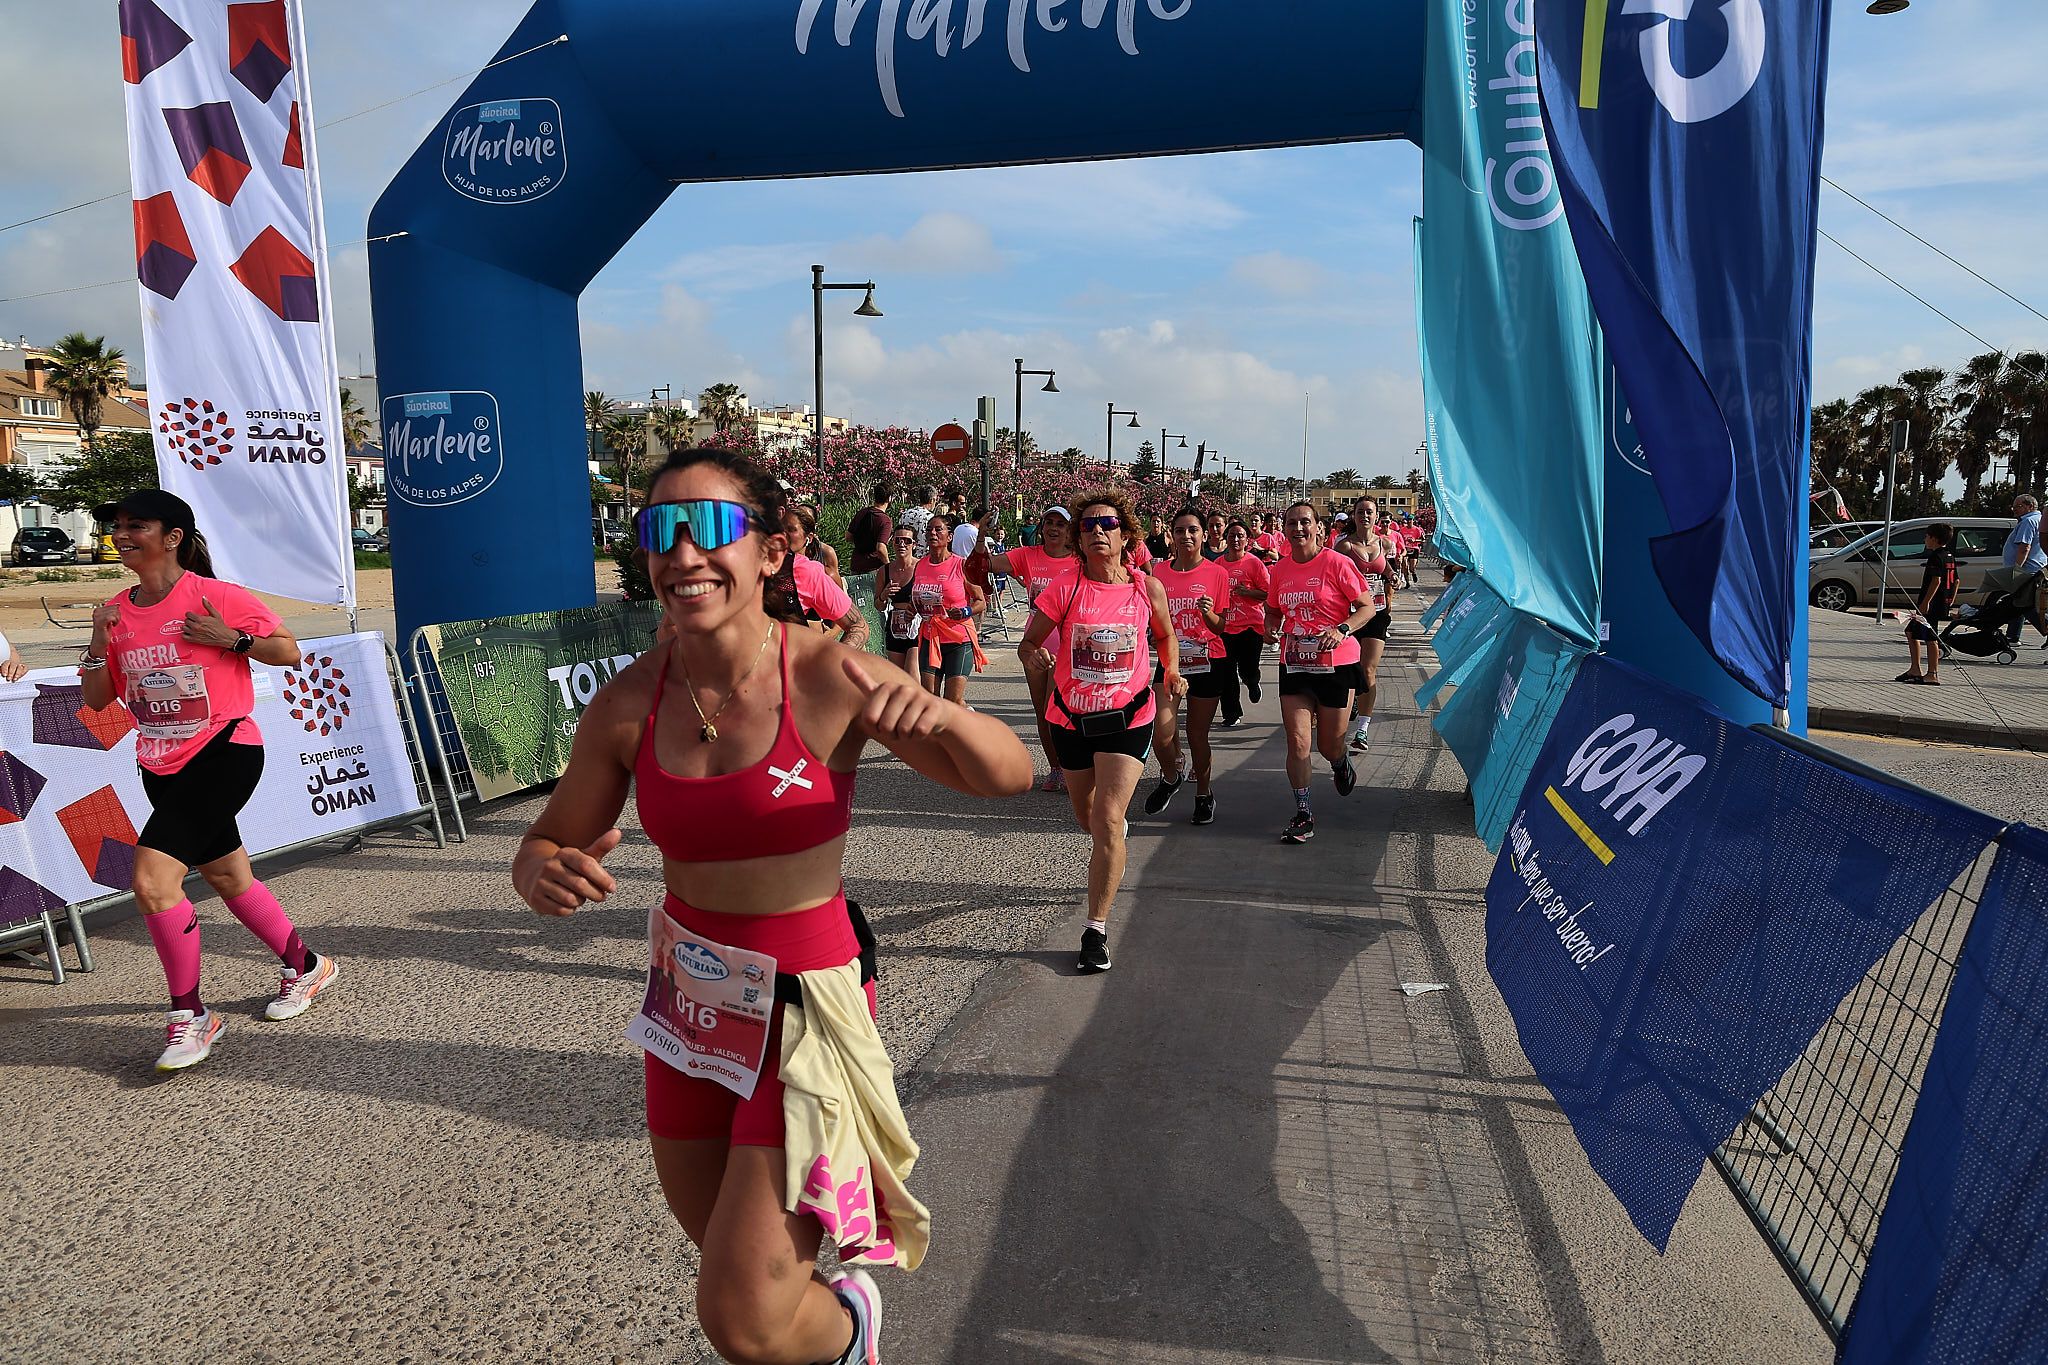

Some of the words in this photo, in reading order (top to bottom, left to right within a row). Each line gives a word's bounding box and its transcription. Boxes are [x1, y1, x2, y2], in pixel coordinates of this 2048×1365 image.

[450, 122, 556, 175] Marlene
[454, 173, 476, 192] HIJA
[478, 187, 493, 196] DE
[496, 188, 517, 197] LOS
[520, 175, 551, 196] ALPES
[388, 417, 491, 477] Marlene
[394, 476, 409, 493] HIJA
[411, 489, 424, 498] DE
[427, 489, 447, 499] LOS
[450, 473, 484, 496] ALPES
[1279, 591, 1315, 606] CARRERA
[1093, 651, 1117, 662] 016
[1299, 652, 1318, 660] 016
[473, 660, 495, 679] 1975
[150, 700, 182, 714] 016
[300, 744, 364, 766] Experience
[1562, 713, 1707, 836] GOYA
[311, 784, 377, 816] OMAN
[1516, 877, 1554, 912] que
[676, 990, 718, 1030] 016
[644, 1027, 680, 1056] OYSHO
[651, 1010, 672, 1030] CARRERA
[713, 1047, 747, 1064] VALENCIA
[700, 1062, 742, 1082] Santander
